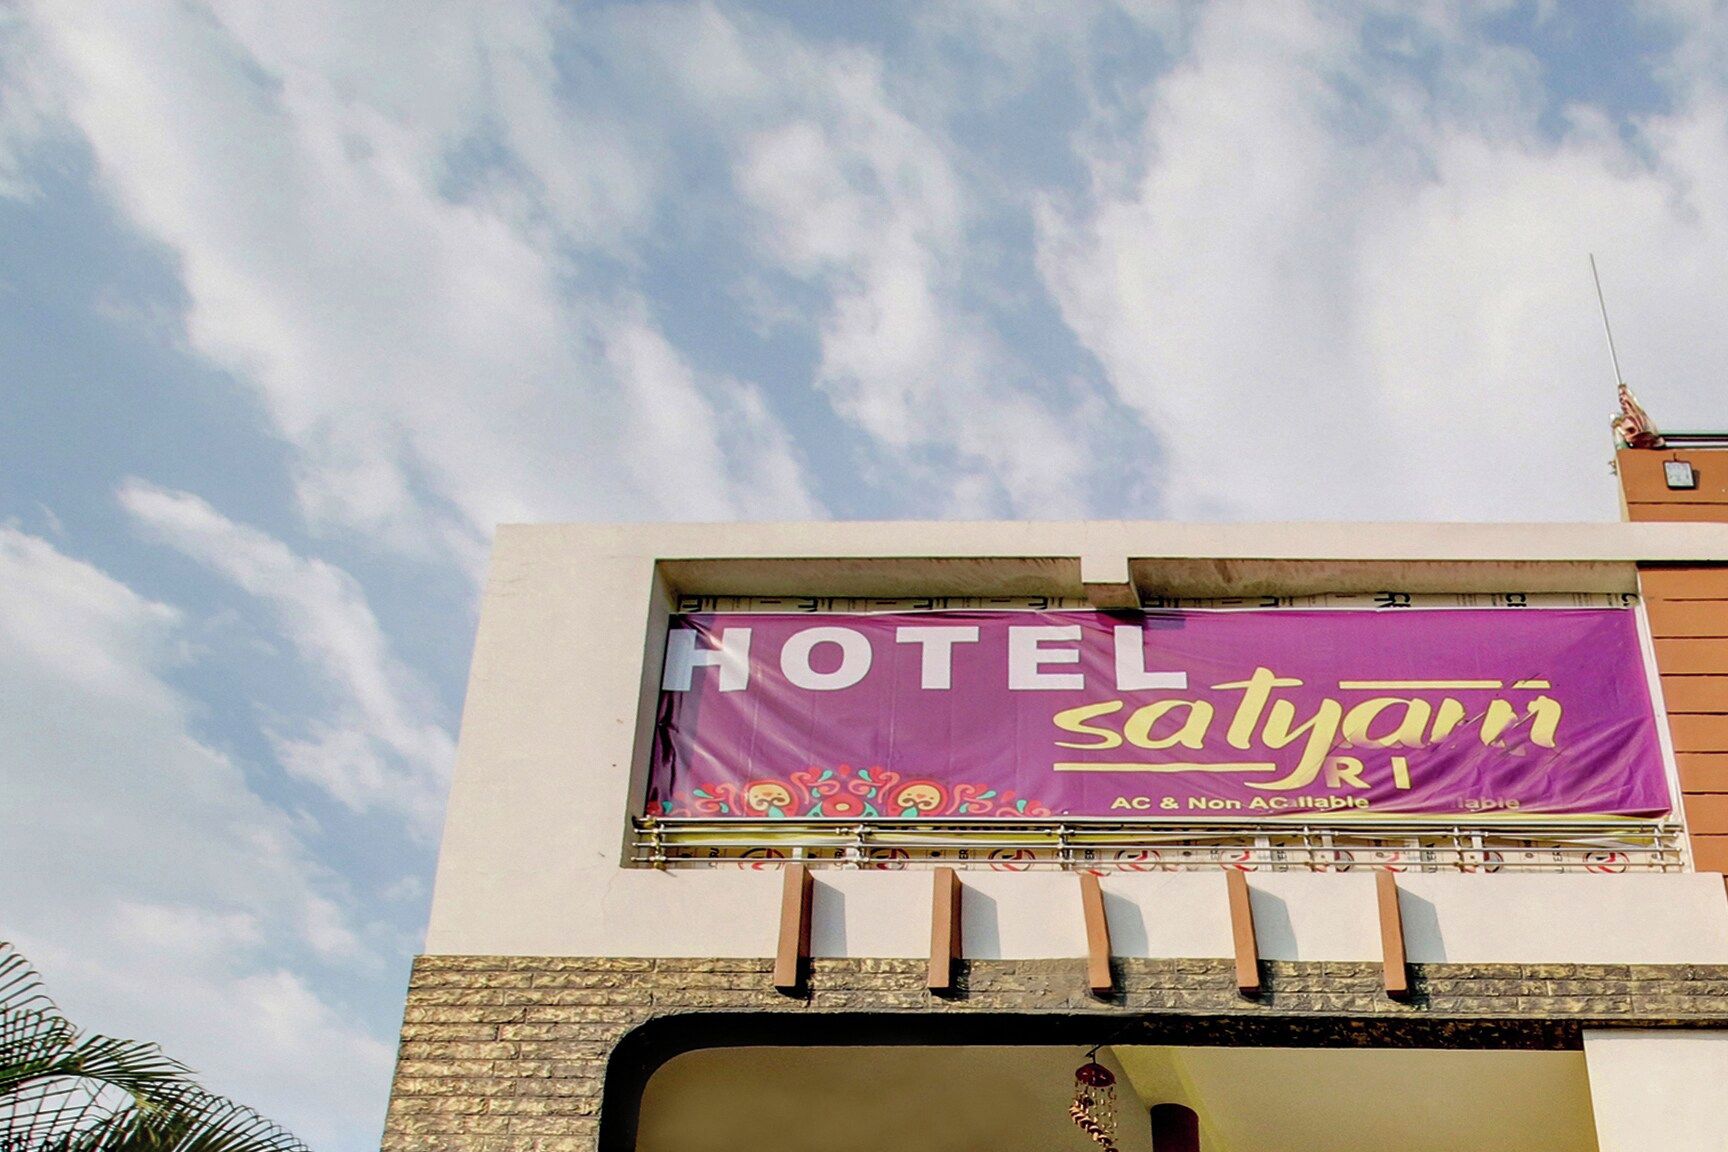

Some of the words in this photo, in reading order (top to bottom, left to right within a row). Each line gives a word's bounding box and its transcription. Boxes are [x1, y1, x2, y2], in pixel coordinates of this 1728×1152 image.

[661, 624, 1188, 692] HOTEL
[1110, 796, 1151, 810] AC
[1160, 796, 1180, 810] &
[1188, 796, 1242, 810] Non
